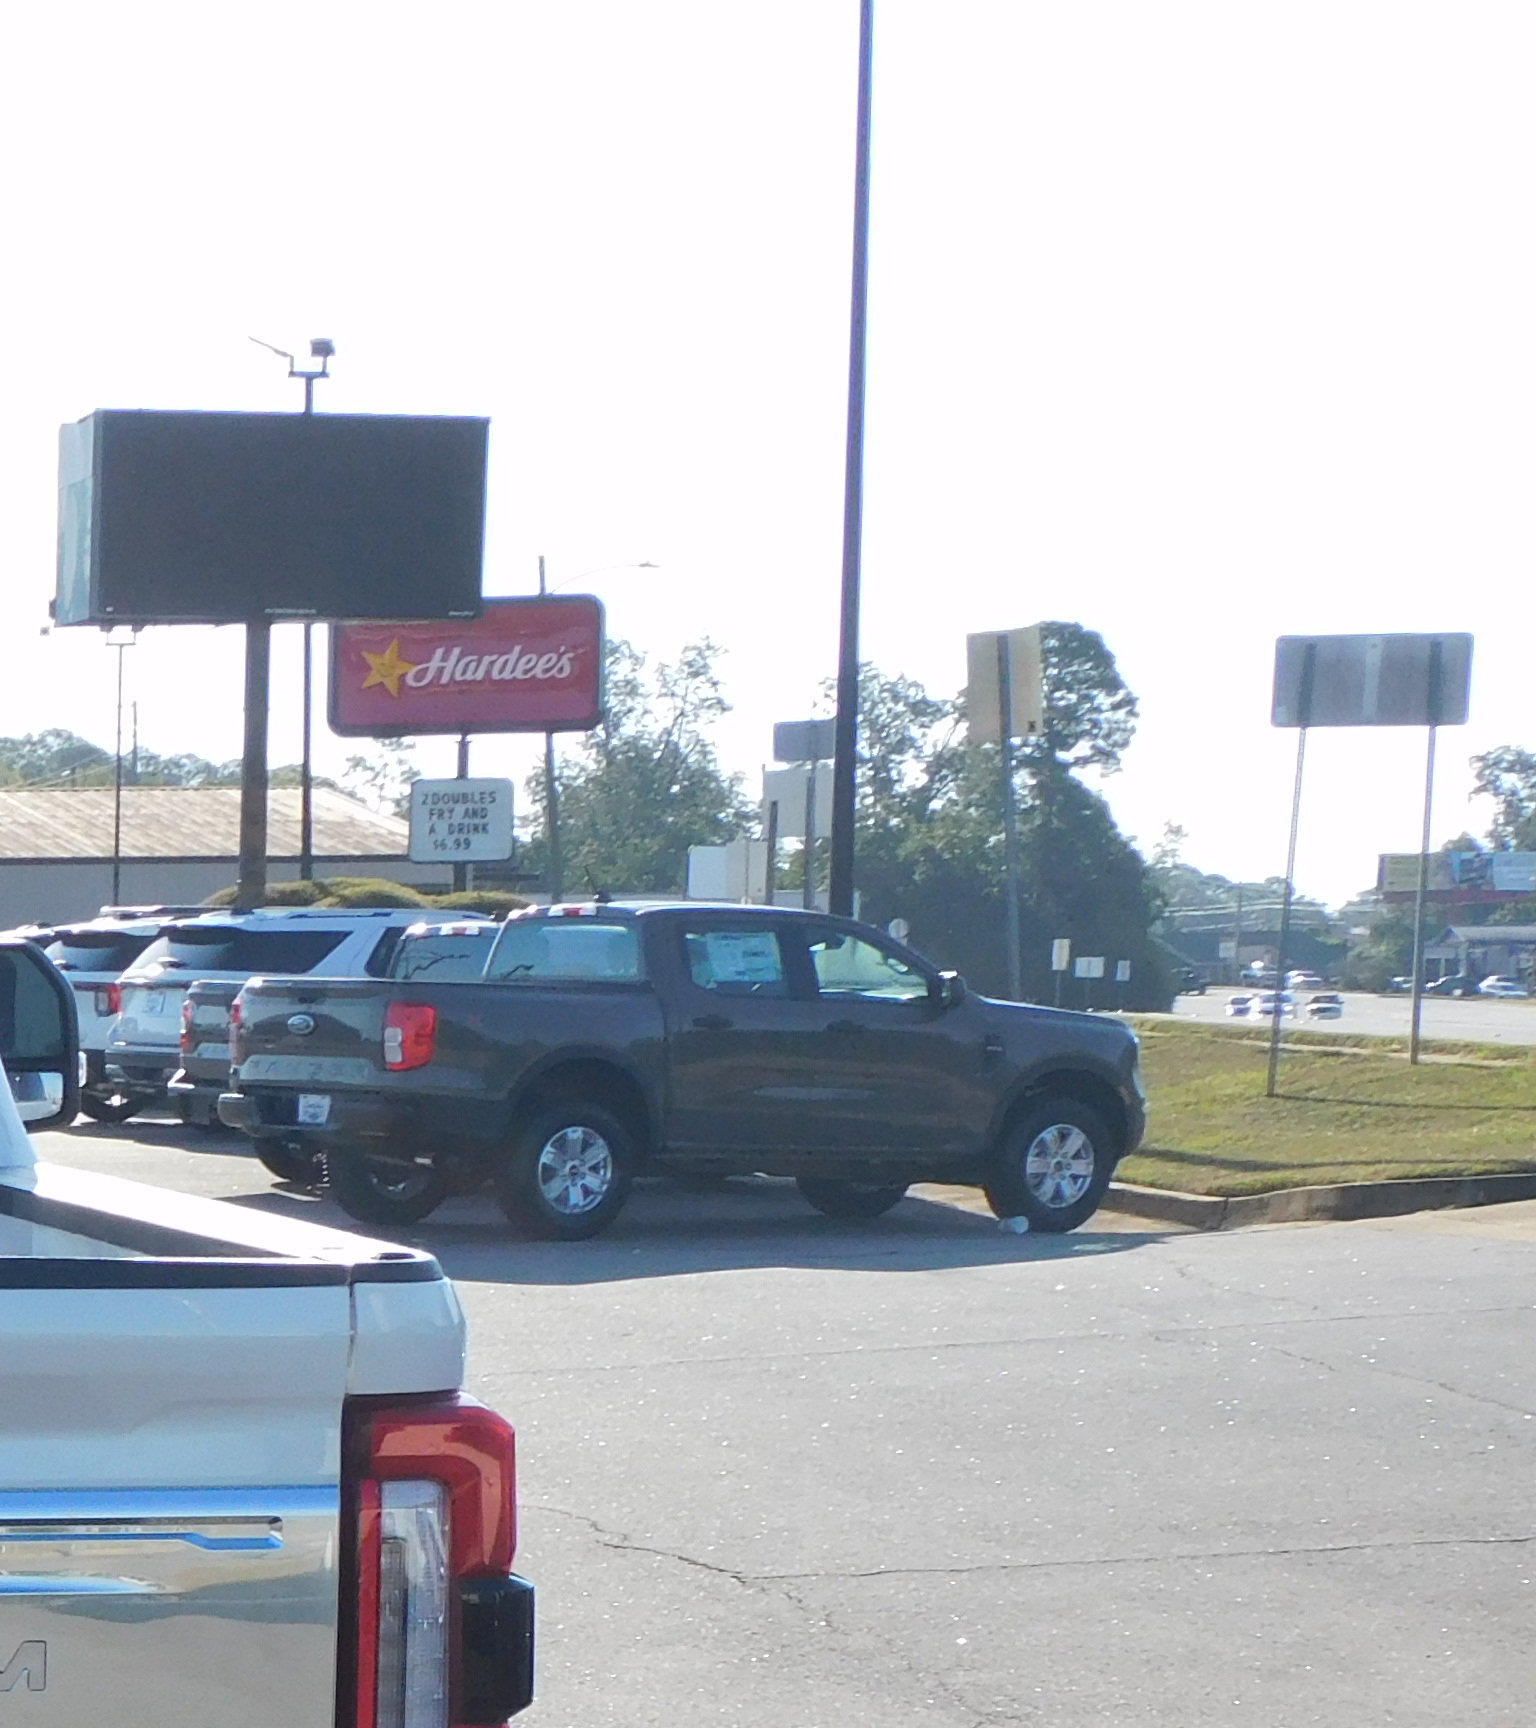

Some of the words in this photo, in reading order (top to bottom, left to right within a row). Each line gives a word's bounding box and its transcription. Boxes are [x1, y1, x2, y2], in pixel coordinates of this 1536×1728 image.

[405, 645, 575, 687] Hardee's
[428, 807, 455, 820] FRY
[461, 807, 488, 820] AND
[428, 823, 437, 836] A
[448, 822, 489, 836] DRINK
[432, 837, 472, 851] $6.99
